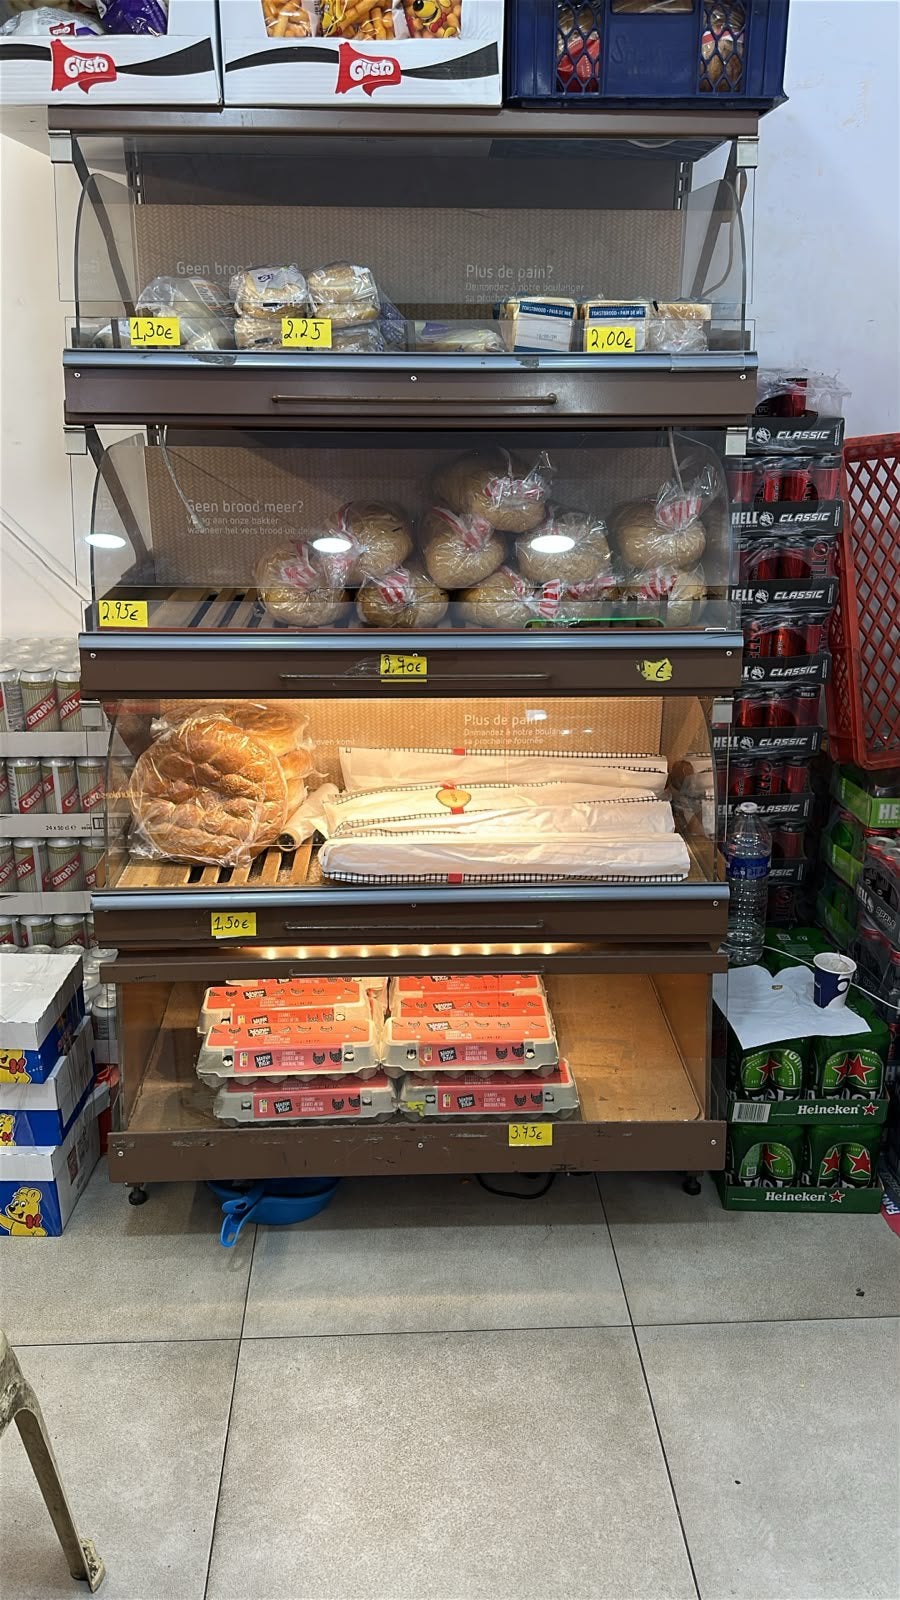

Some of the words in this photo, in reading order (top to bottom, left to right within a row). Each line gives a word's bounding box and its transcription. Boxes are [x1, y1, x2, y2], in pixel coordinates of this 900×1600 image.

[176, 262, 210, 275] Geen
[466, 265, 493, 278] Plus
[498, 265, 513, 278] de
[518, 265, 553, 281] pain?
[518, 283, 541, 291] notre
[543, 283, 584, 294] boulanger
[132, 320, 174, 341] 1,30€
[591, 328, 633, 349] 2,00€
[776, 430, 831, 440] CLASSIC
[222, 500, 260, 512] brood
[264, 500, 304, 512] meer?
[229, 517, 250, 525] onze
[252, 516, 279, 525] bakker
[731, 512, 759, 525] HELL
[779, 512, 831, 523] CLASSIC
[225, 526, 238, 534] het
[240, 527, 258, 535] vers
[259, 526, 283, 535] brood
[774, 590, 825, 600] CLASSIC
[769, 666, 818, 677] CLASSIC
[464, 714, 490, 726] Plus
[493, 714, 508, 726] de
[513, 729, 533, 737] notre
[475, 737, 512, 746] prochaine
[713, 736, 740, 748] HELL
[759, 737, 808, 747] CLASSIC
[797, 1105, 859, 1115] Heineken
[765, 1191, 826, 1202] Heineken
